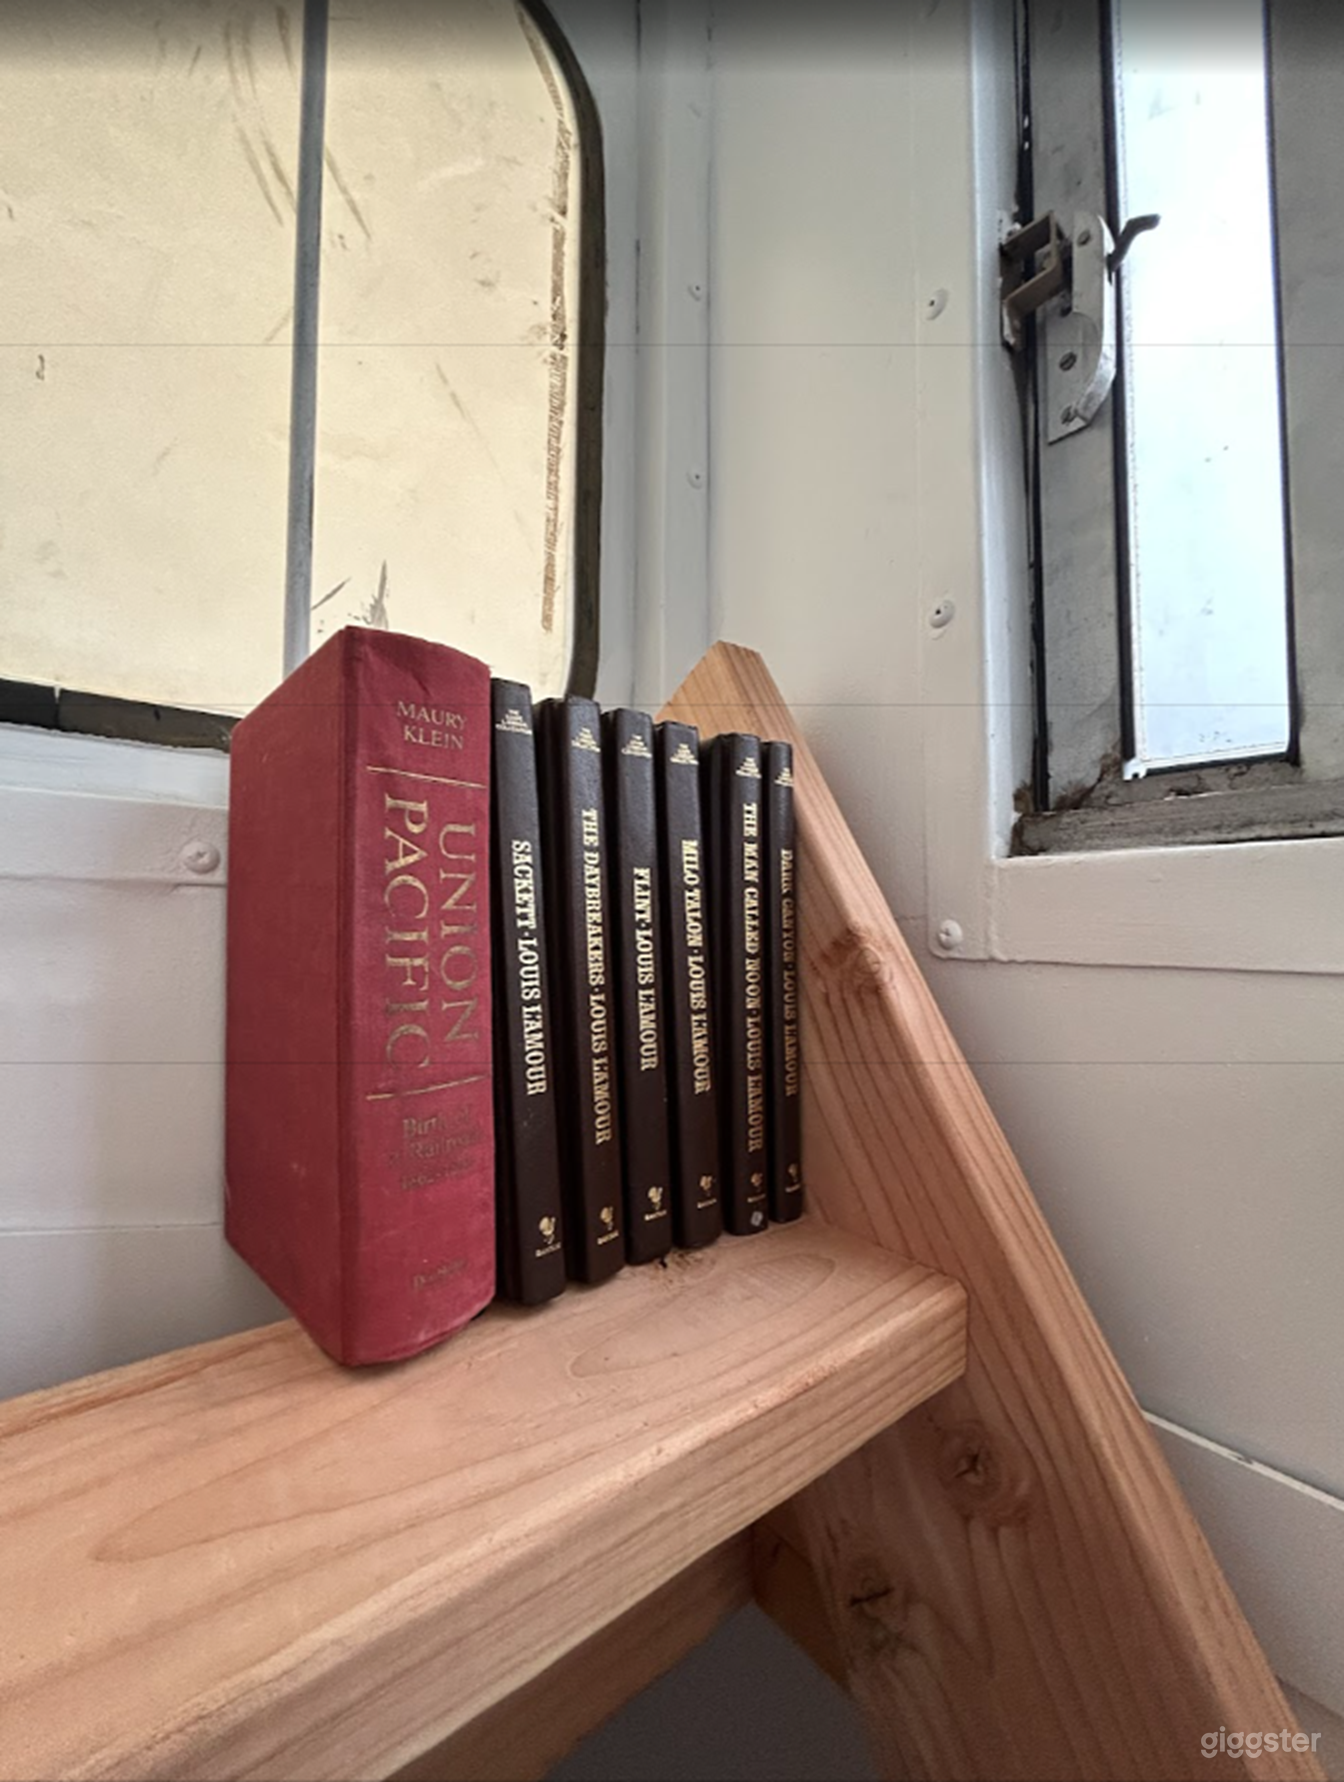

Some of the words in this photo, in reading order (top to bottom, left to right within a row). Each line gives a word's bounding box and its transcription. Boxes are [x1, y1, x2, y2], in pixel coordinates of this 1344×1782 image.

[396, 700, 467, 730] MAURY
[403, 724, 464, 750] KLEIN
[581, 808, 599, 847] THE
[742, 802, 758, 837] THE
[511, 839, 537, 930] SACKETT
[682, 839, 700, 885] MILO
[743, 841, 759, 883] MAN
[780, 848, 793, 895] DARK
[583, 851, 605, 986] DAYBREAKERS
[633, 867, 651, 923] FLINT
[684, 888, 703, 947] TALON
[744, 887, 760, 954] CALLED
[384, 792, 430, 1069] PACIFIC
[438, 822, 479, 1042] UNION
[635, 928, 655, 985] LOUIS
[781, 898, 795, 963] CANYON
[517, 937, 542, 1001] LOUIS
[687, 955, 708, 1010] LOUIS
[745, 957, 761, 1009] NOON
[783, 970, 797, 1020] LOUIS
[521, 1004, 547, 1096] L'AMOUR
[589, 993, 608, 1054] LOUIS
[638, 988, 658, 1072] L'AMOUR
[746, 1016, 763, 1072] LOUIS
[691, 1012, 712, 1095] L'AMOUR
[592, 1056, 612, 1145] L'AMOUR
[747, 1074, 765, 1153] L'AMOUR
